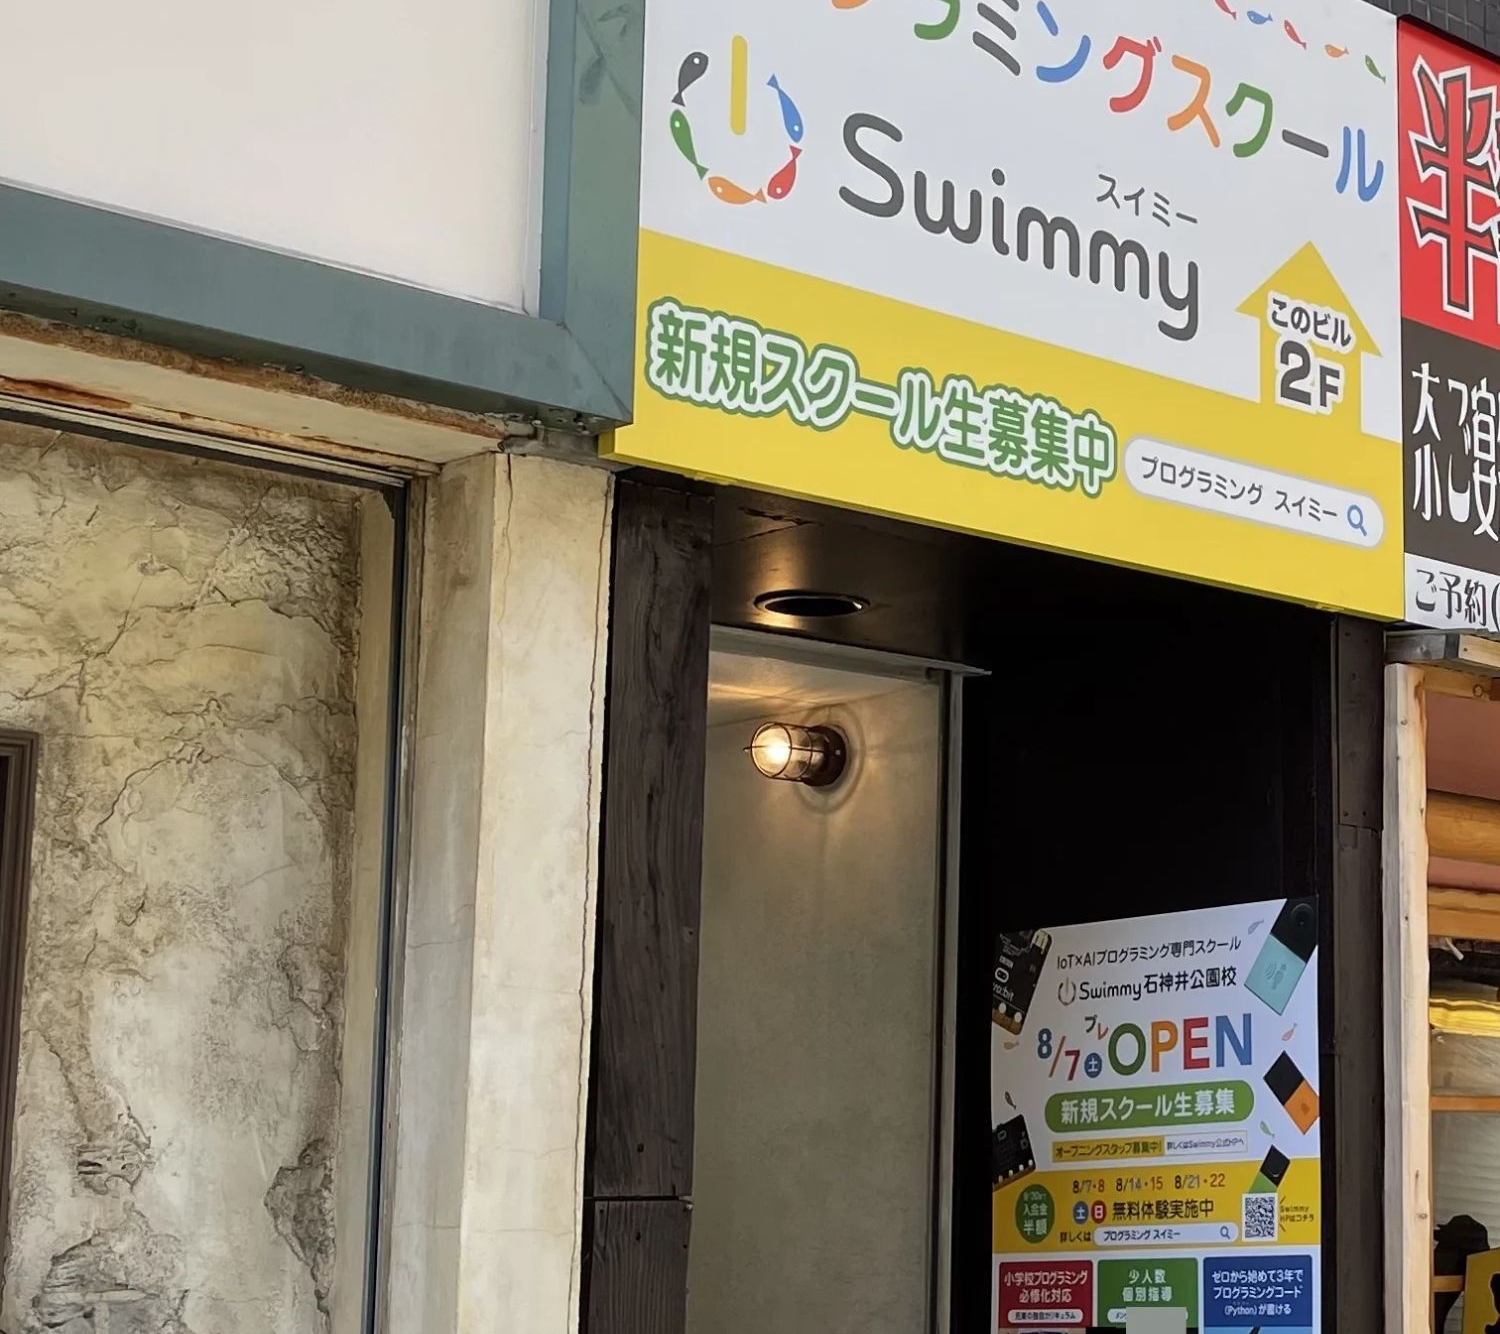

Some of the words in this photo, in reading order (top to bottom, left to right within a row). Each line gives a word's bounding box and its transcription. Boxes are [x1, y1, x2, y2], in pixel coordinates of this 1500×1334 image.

[838, 112, 1201, 343] Swimmy
[1097, 173, 1199, 229] スイミー
[1269, 297, 1352, 349] このビル
[652, 312, 1115, 493] 新規スクール生募集中
[1275, 339, 1343, 411] 2F
[1141, 455, 1264, 507] プログラミング
[1274, 488, 1340, 523] スイミー
[1107, 1013, 1253, 1077] OPEN
[1060, 1088, 1236, 1126] 新規スクール生募集
[1111, 1199, 1215, 1222] 無料体験実施中
[1211, 1268, 1304, 1284] ゼロから始めて3年で
[1213, 1285, 1304, 1300] プログラミングコード
